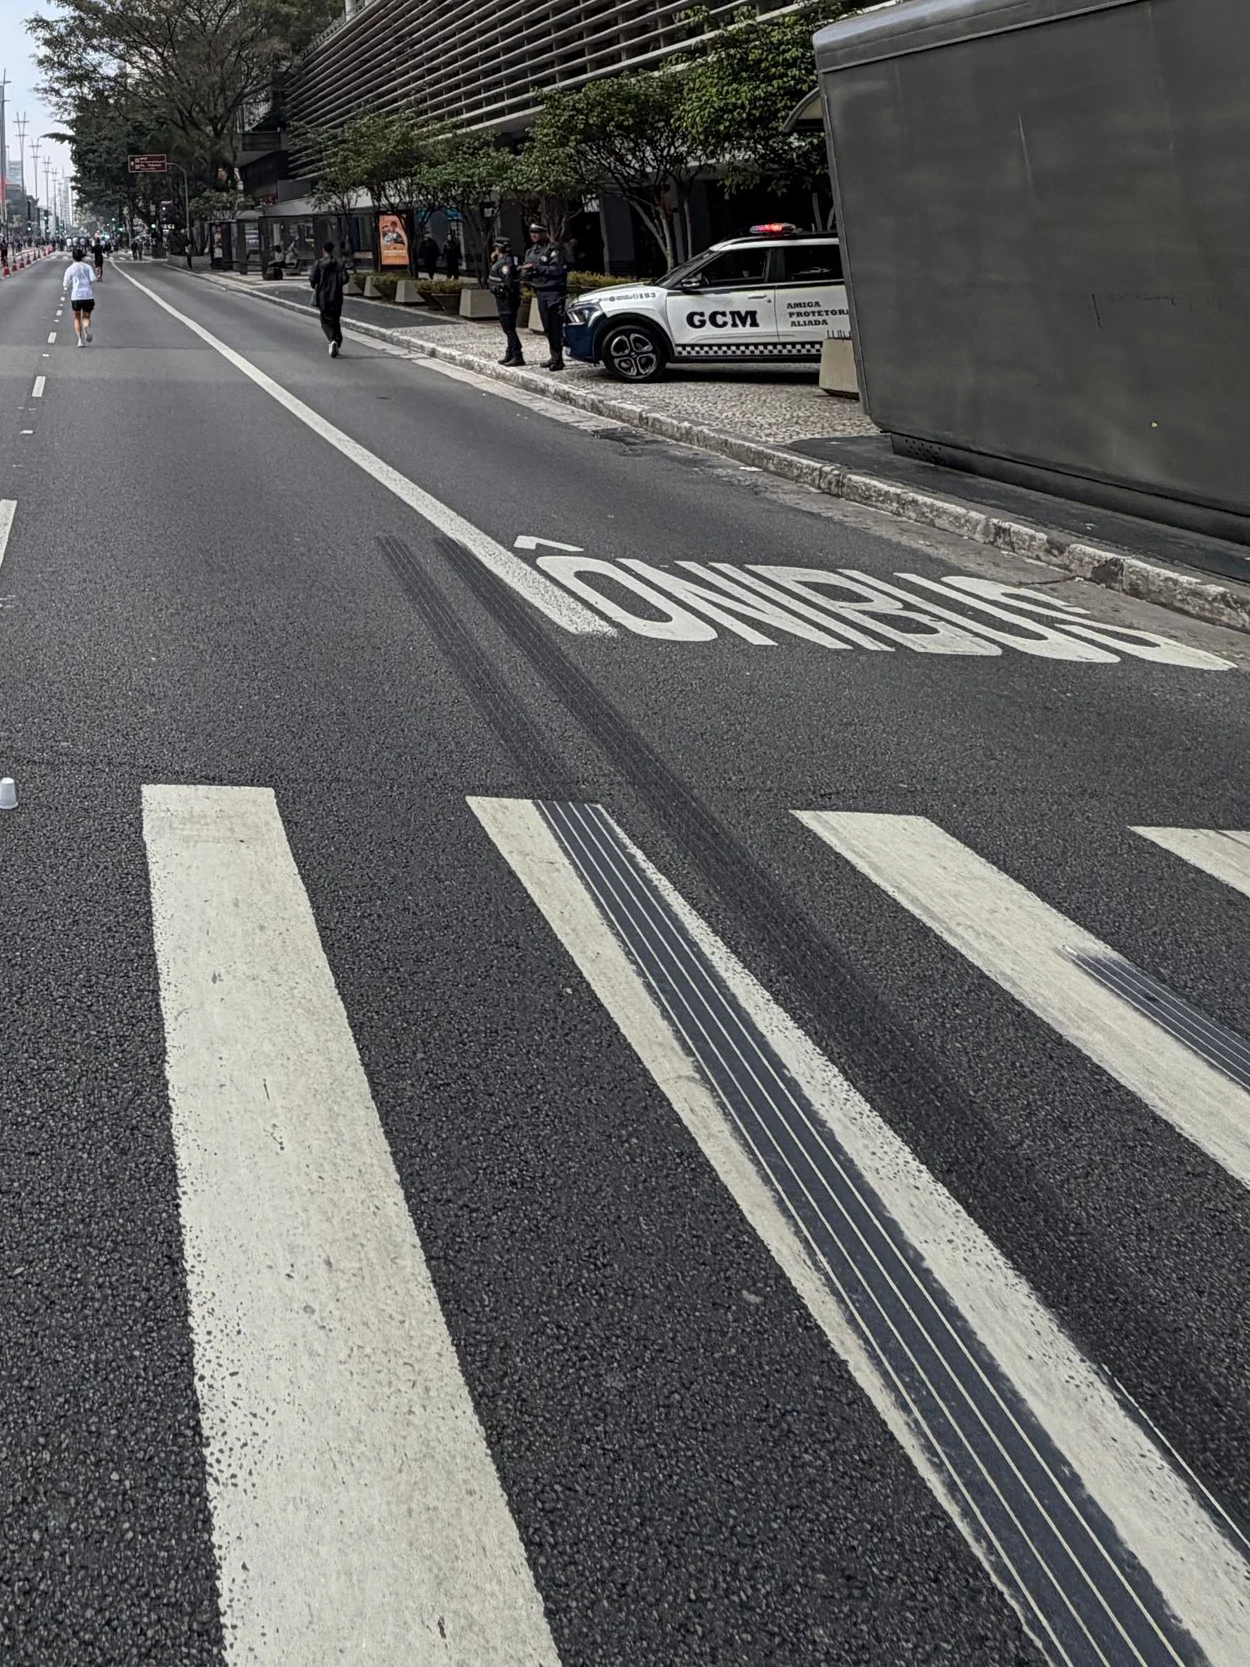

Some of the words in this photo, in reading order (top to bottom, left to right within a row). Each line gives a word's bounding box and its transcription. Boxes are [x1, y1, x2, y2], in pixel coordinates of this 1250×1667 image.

[787, 301, 821, 309] AMIGA
[686, 310, 760, 329] GCM
[791, 319, 829, 327] ALIADA
[514, 535, 1239, 671] ÔNIBUS
